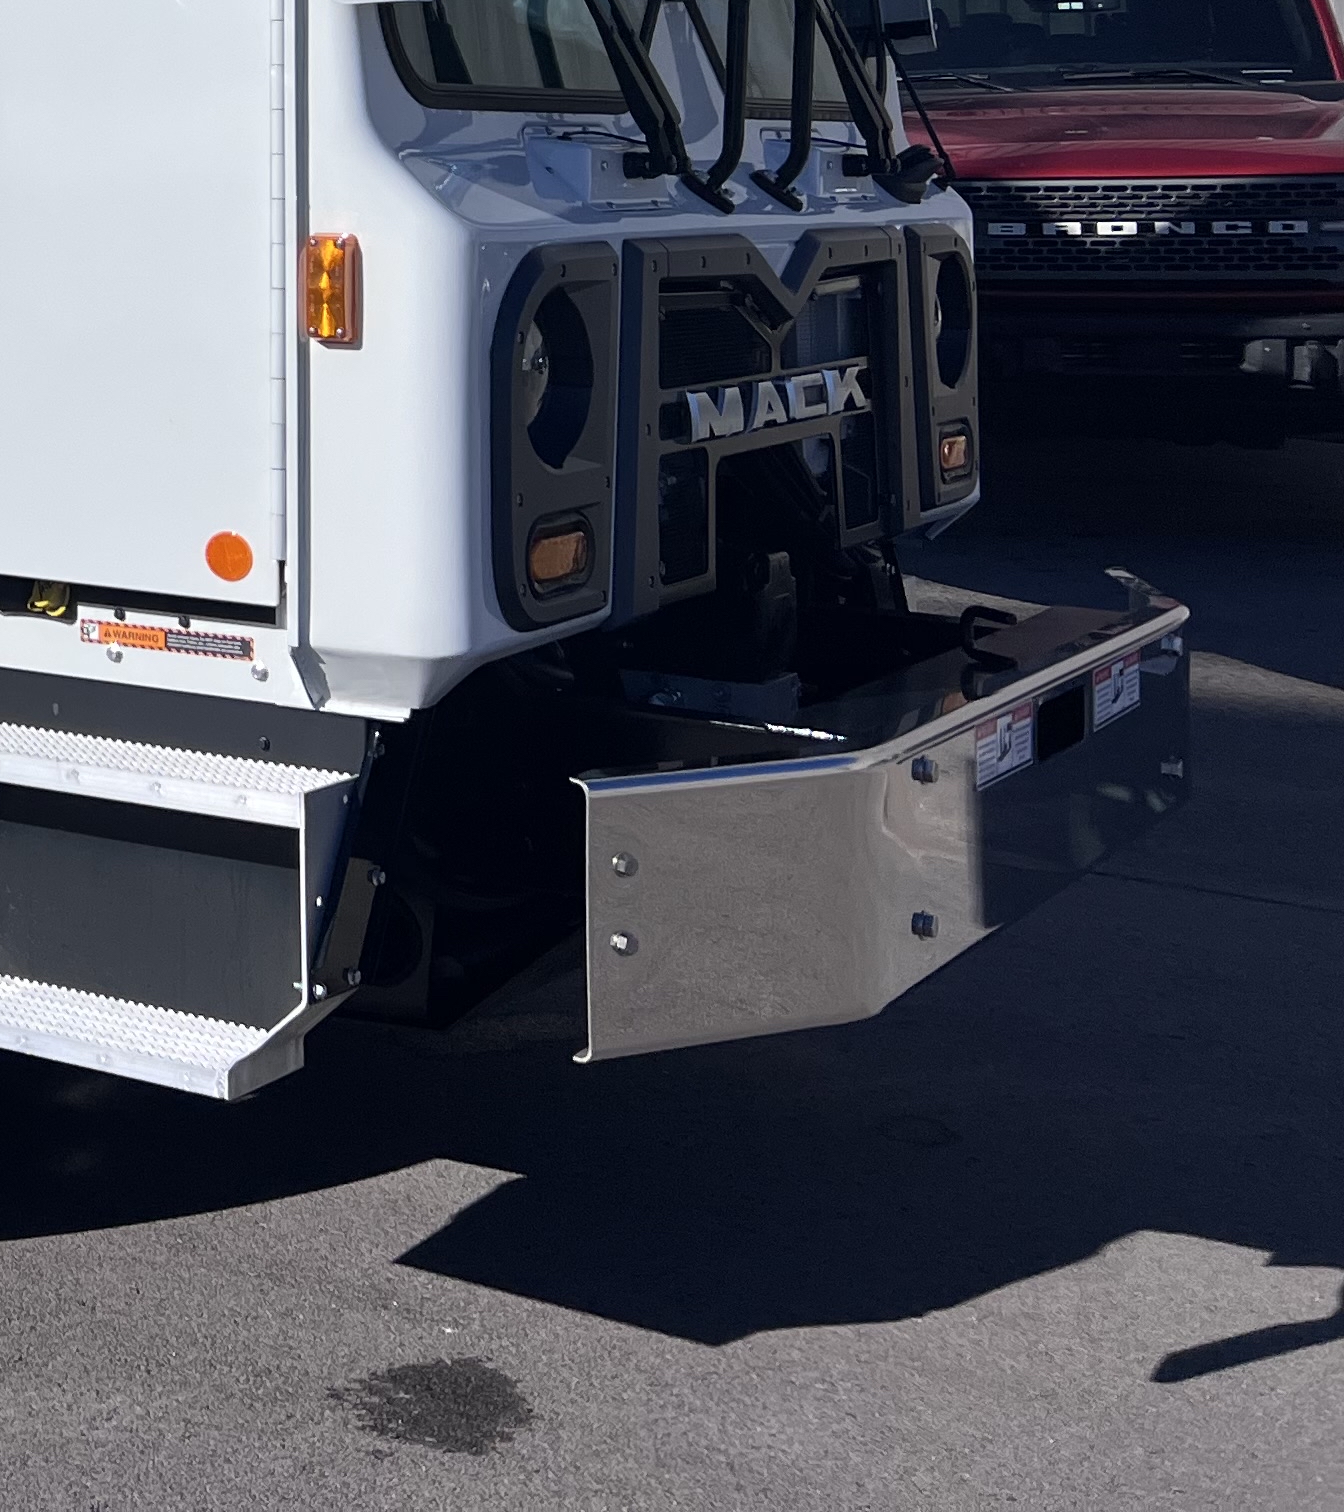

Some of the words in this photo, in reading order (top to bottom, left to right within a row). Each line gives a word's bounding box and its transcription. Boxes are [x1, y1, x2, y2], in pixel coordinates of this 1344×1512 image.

[987, 221, 1309, 236] BRONCO
[686, 366, 867, 443] MACK
[112, 629, 159, 643] WARNING
